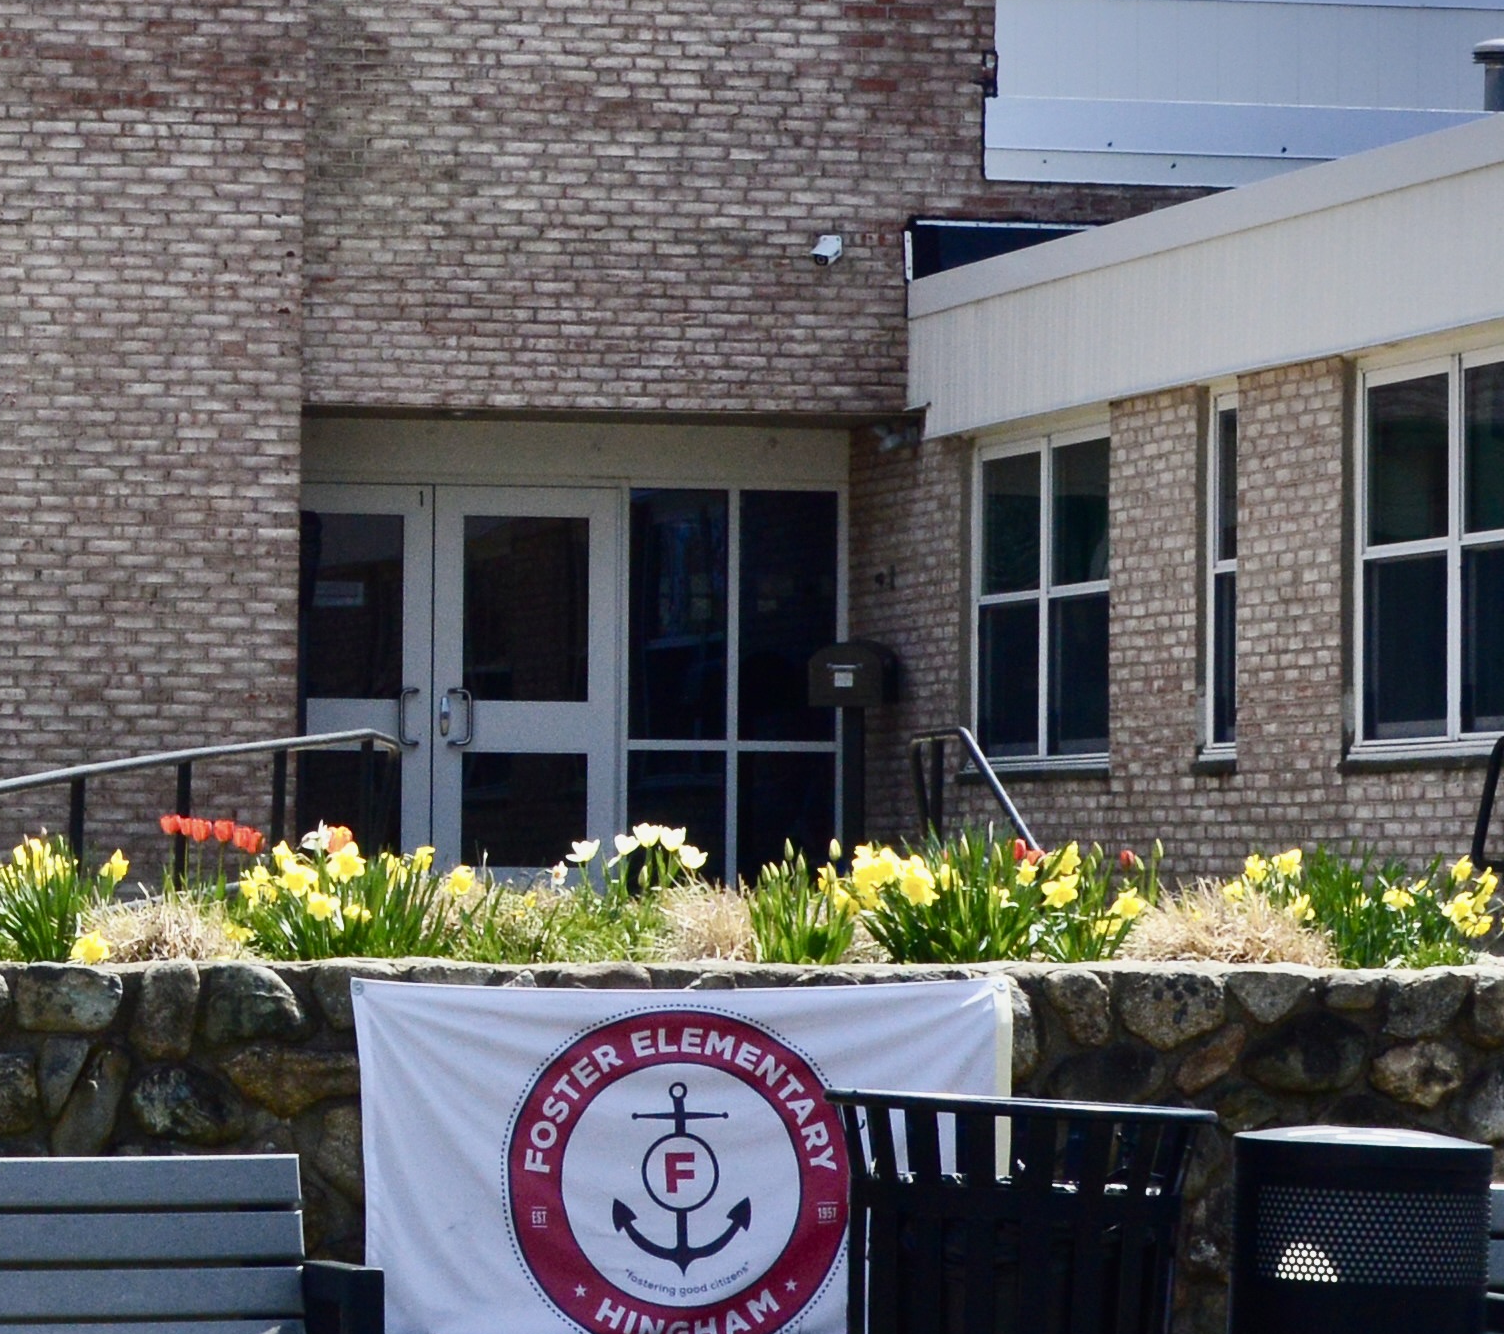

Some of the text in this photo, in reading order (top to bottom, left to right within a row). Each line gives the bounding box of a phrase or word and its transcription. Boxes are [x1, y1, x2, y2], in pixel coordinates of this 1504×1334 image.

[419, 490, 424, 507] 1
[524, 1027, 838, 1175] FOSTER ELEMENTARY
[664, 1152, 695, 1194] F
[532, 1211, 547, 1224] EST
[679, 1283, 708, 1297] good
